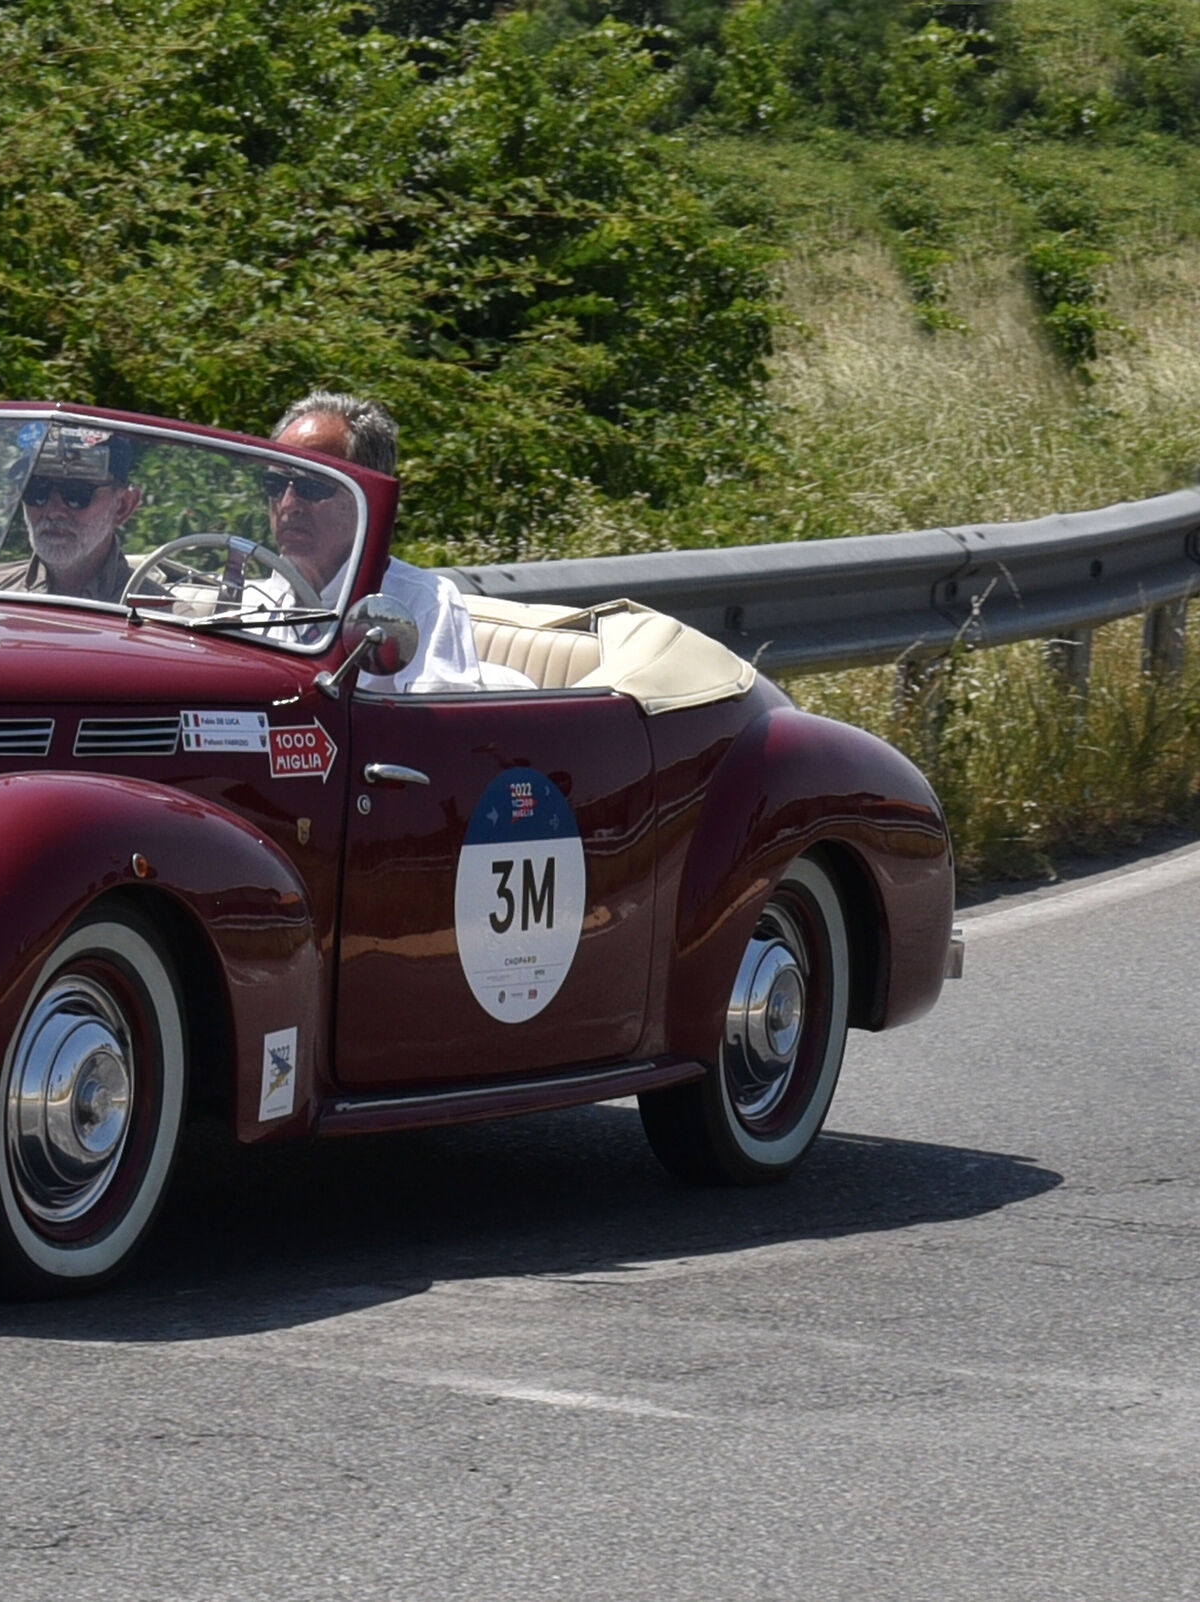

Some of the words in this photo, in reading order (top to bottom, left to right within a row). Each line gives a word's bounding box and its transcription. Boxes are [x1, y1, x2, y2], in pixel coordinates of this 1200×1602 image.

[276, 733, 317, 750] 1000
[276, 753, 322, 771] MIGLIA
[510, 782, 533, 798] 2022
[488, 856, 556, 934] 3M
[504, 955, 538, 967] CHOPARD
